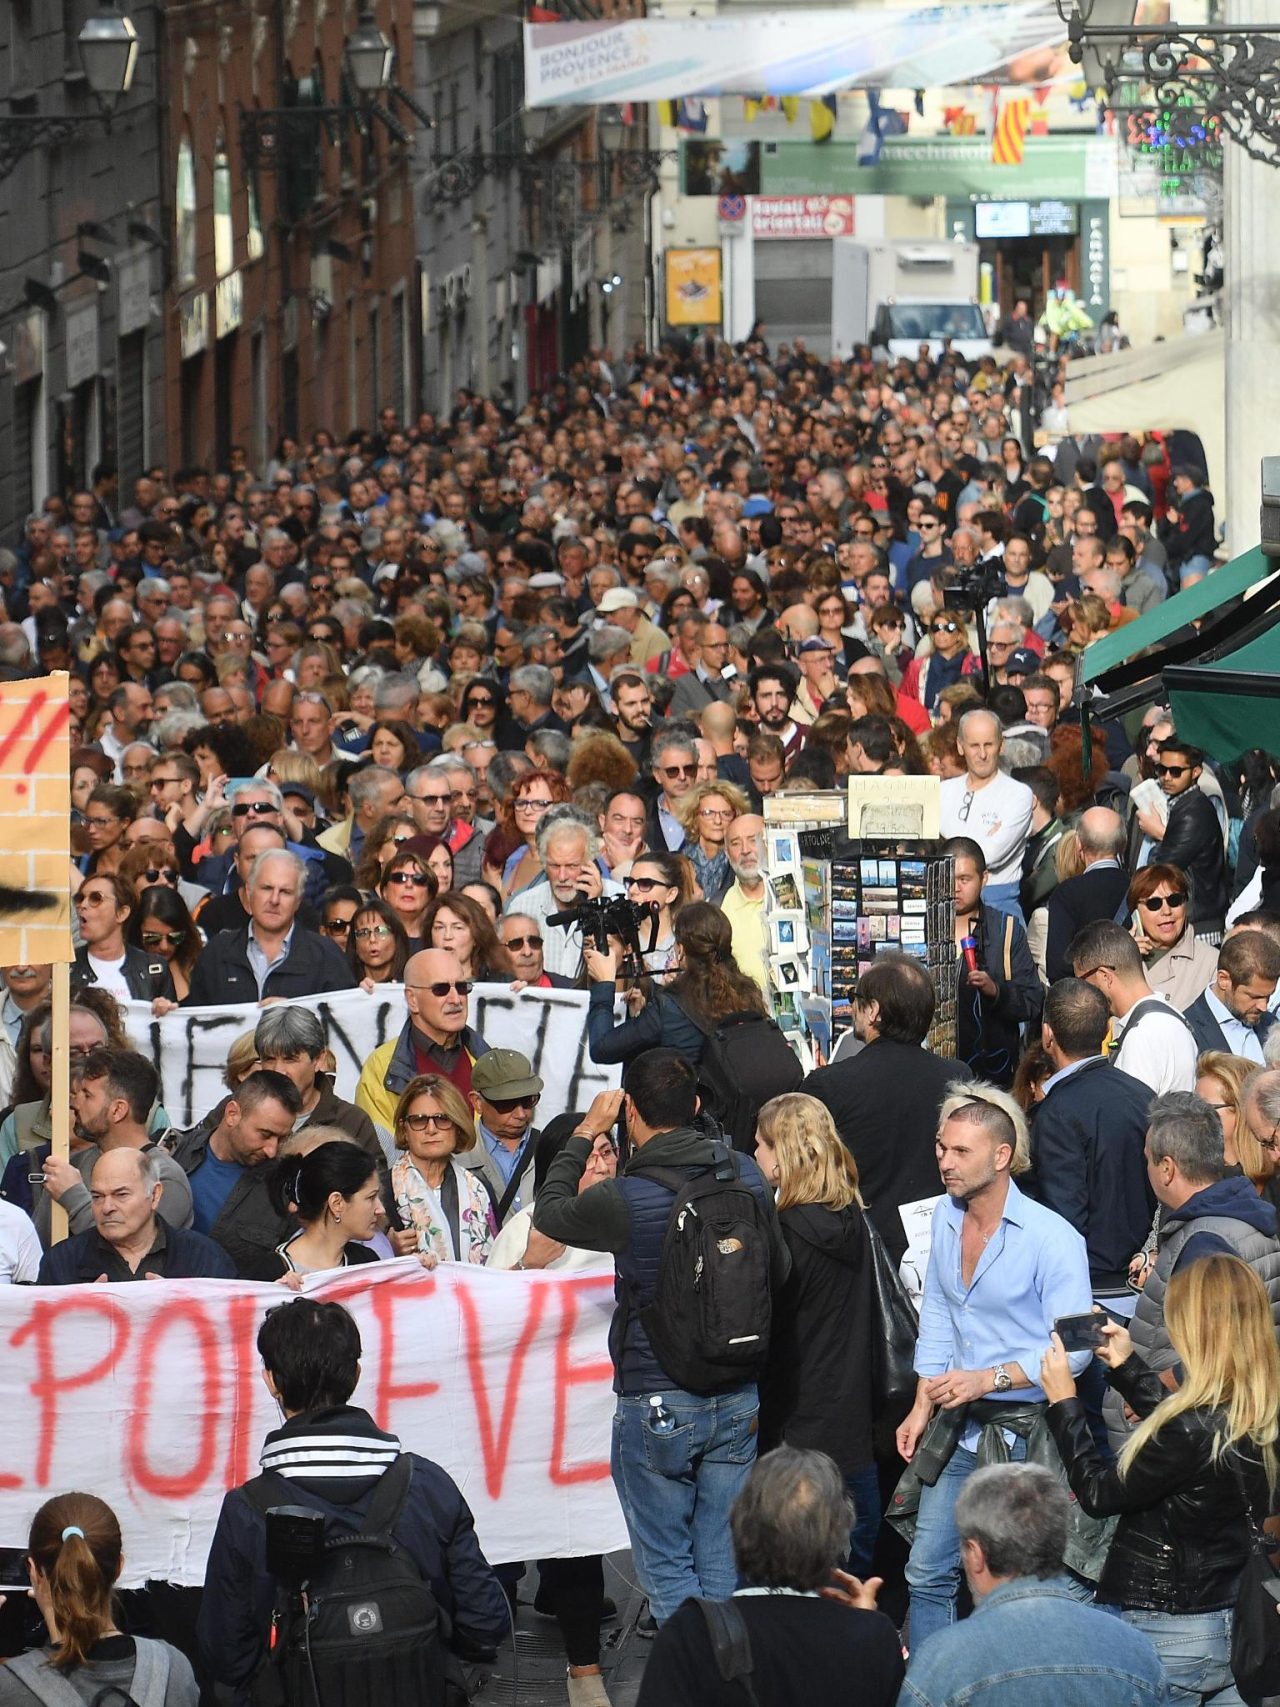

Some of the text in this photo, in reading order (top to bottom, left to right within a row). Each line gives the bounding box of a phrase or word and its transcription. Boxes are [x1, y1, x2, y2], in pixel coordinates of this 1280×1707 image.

[540, 31, 624, 67] BONJOUR
[540, 44, 633, 83] PROVENCE
[1089, 217, 1104, 306] FARMACIA
